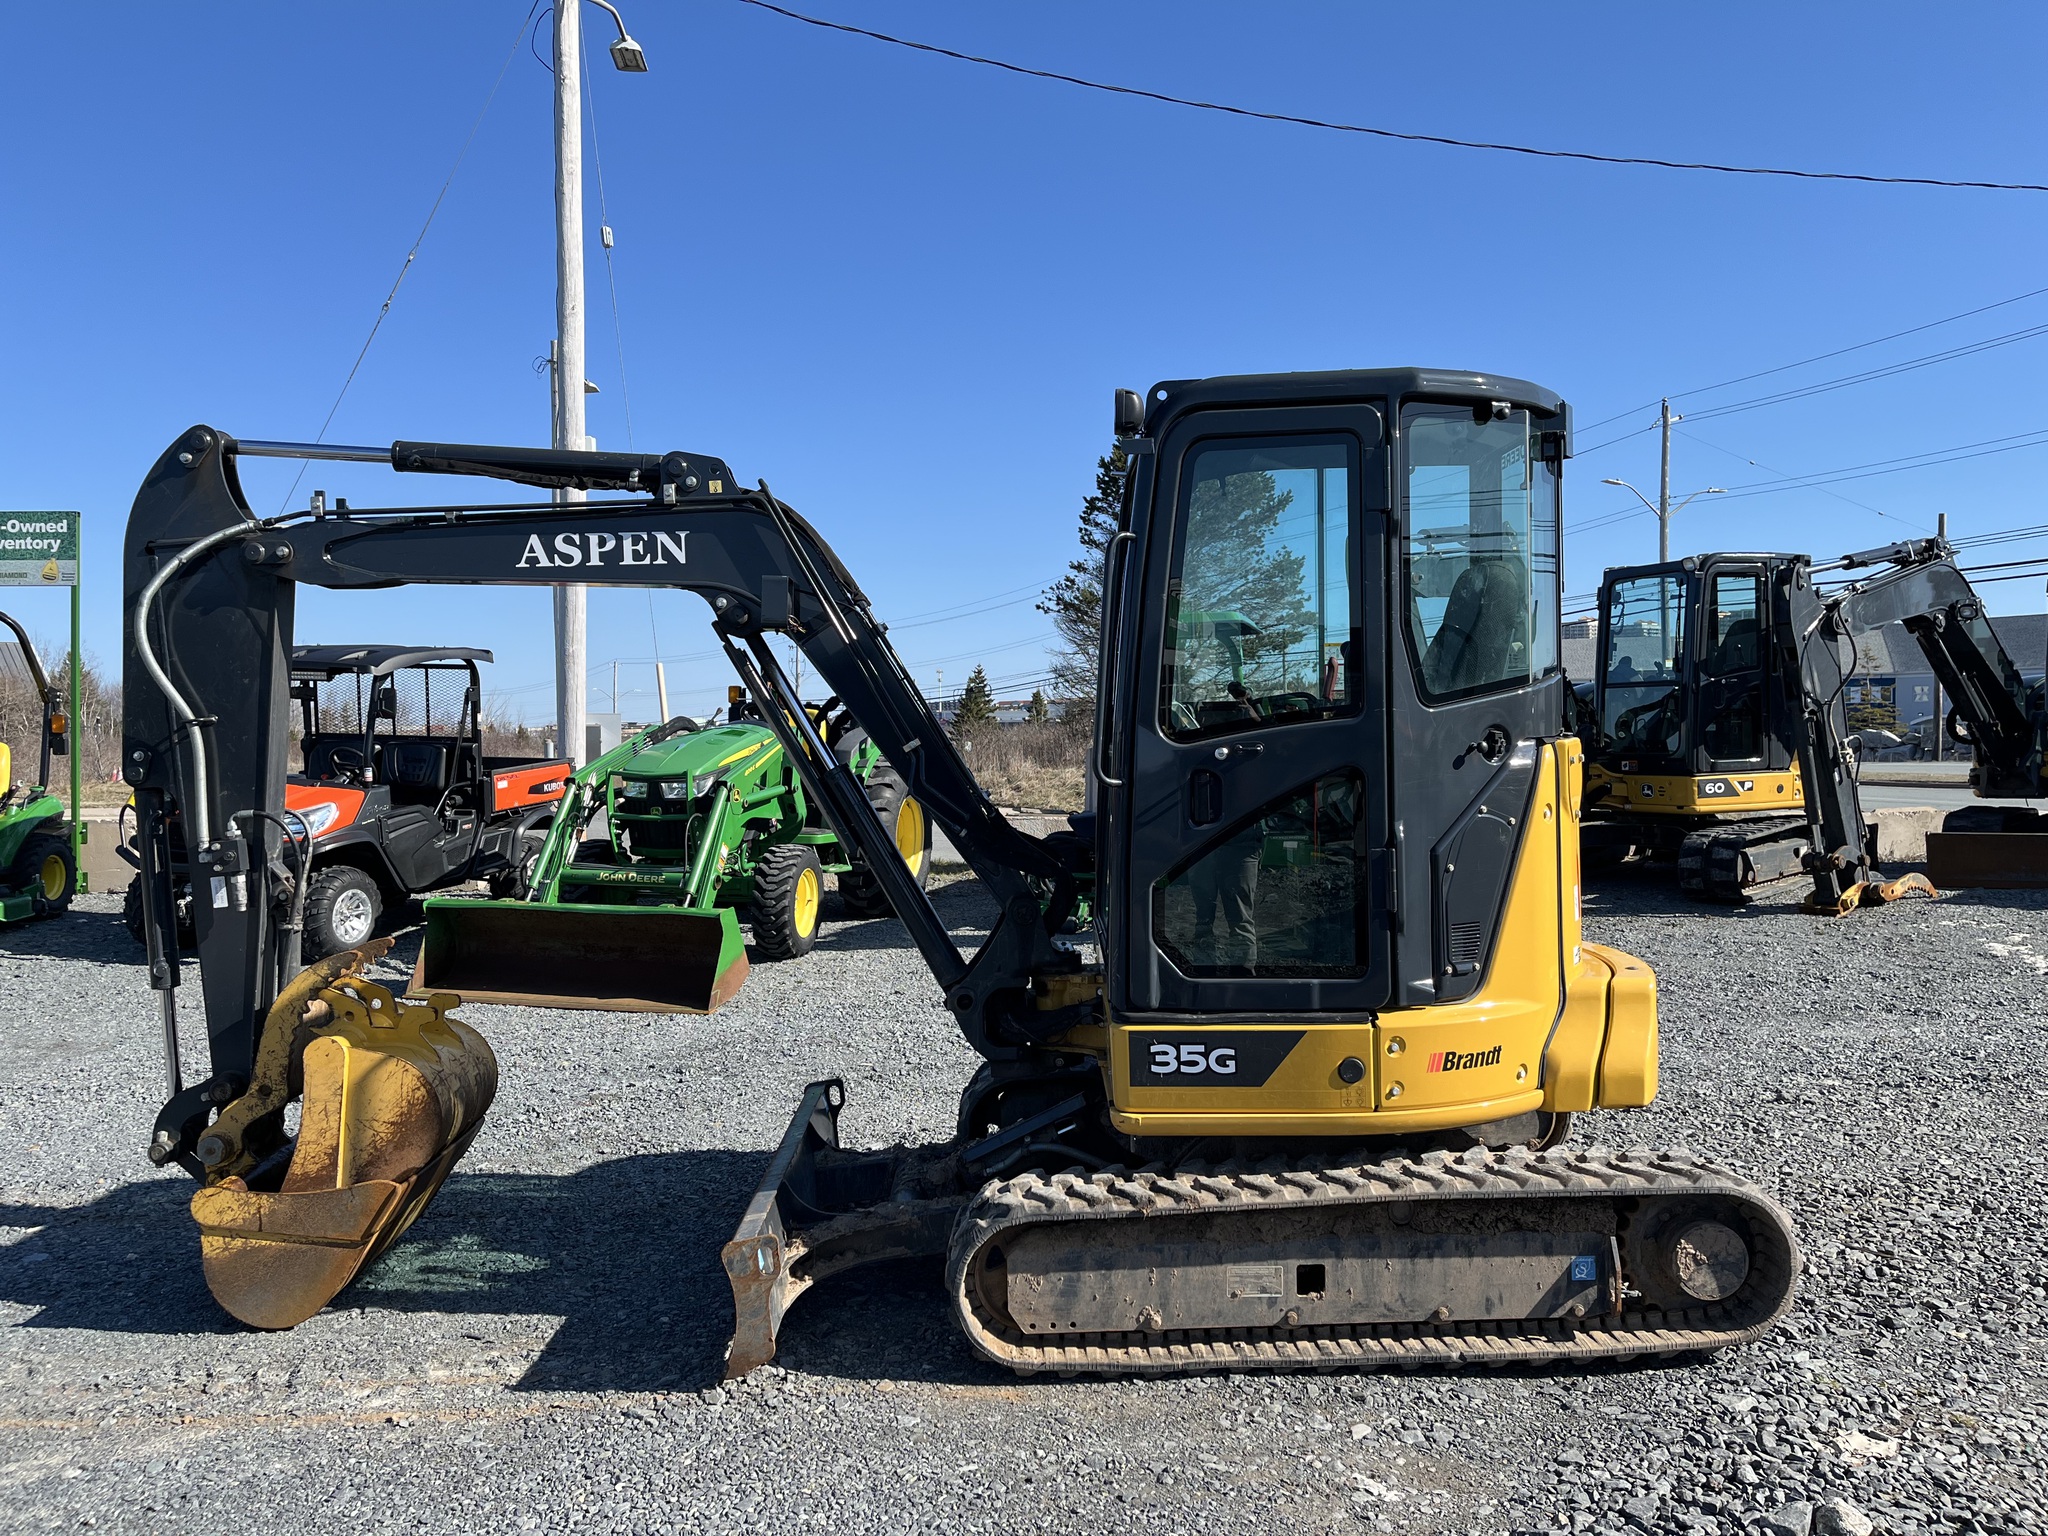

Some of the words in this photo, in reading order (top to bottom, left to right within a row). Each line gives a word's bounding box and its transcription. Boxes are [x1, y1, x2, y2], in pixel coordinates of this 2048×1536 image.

[515, 531, 690, 568] ASPEN
[543, 781, 567, 793] KUBOT
[1705, 782, 1725, 794] 60
[596, 871, 626, 882] JOHN
[628, 872, 666, 884] DEERE
[1150, 1044, 1236, 1074] 35G
[1442, 1045, 1502, 1072] Brandt
